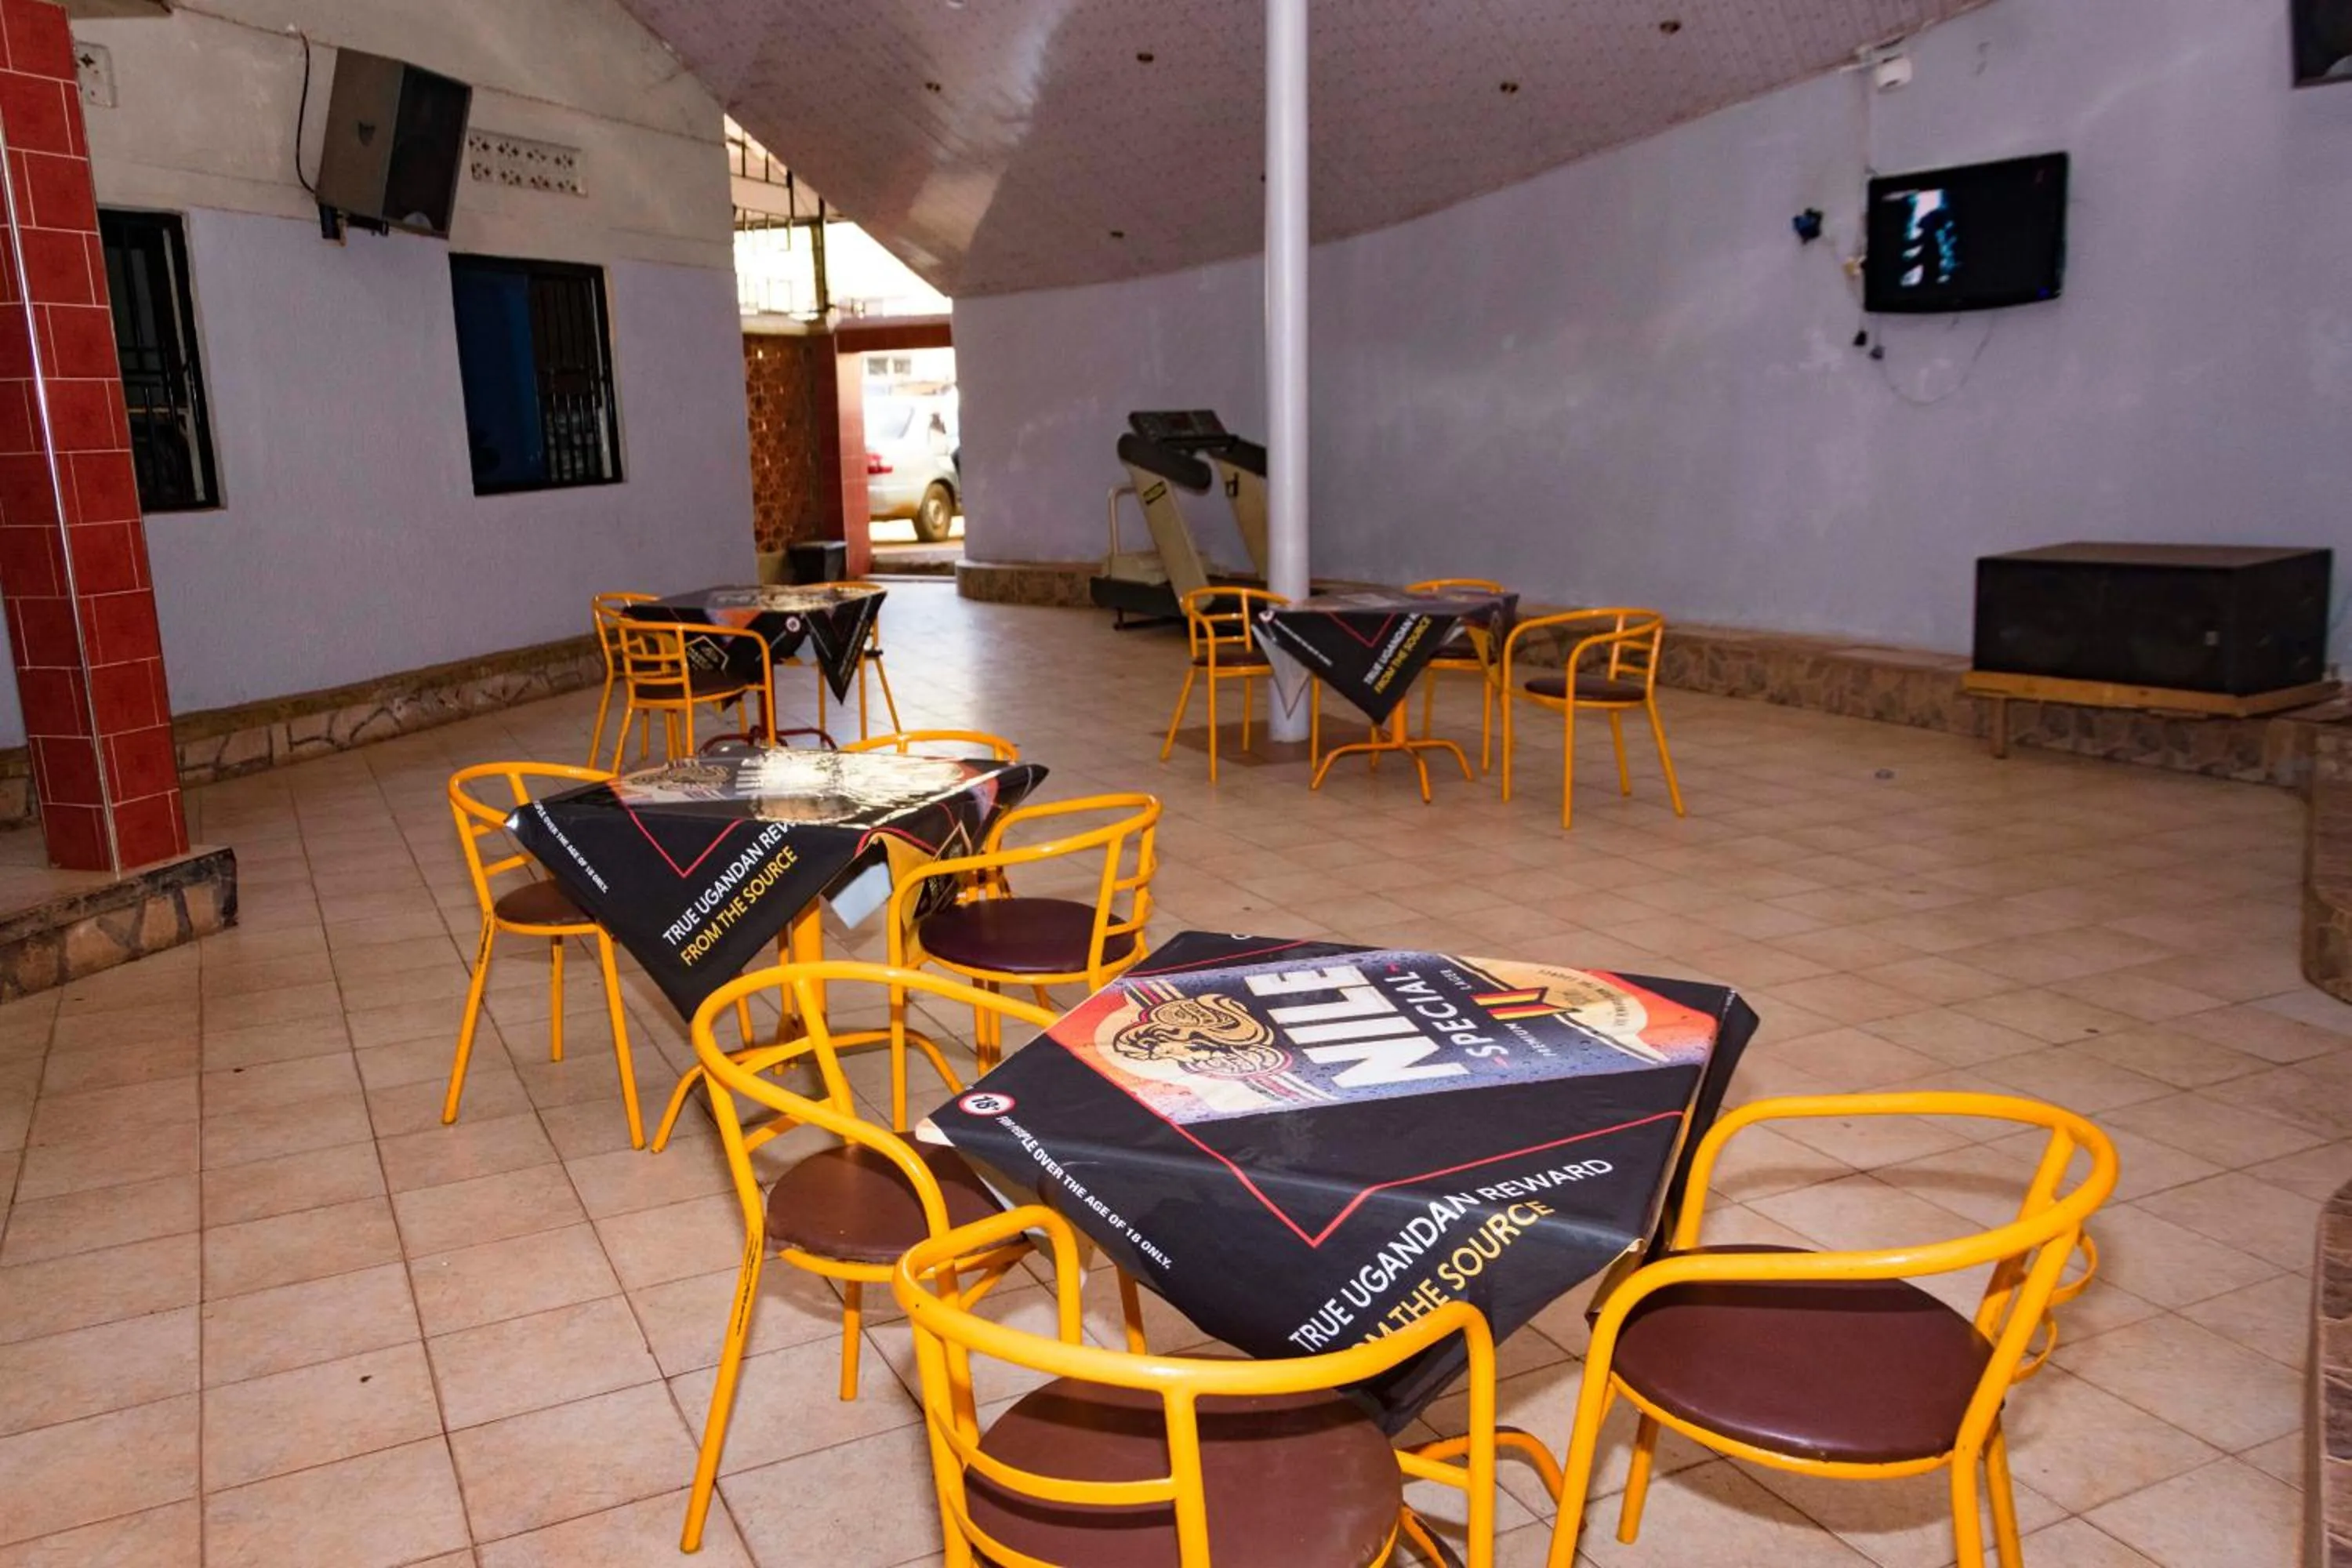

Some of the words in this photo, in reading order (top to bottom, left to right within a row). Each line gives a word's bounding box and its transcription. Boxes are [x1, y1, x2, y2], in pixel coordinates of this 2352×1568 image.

[662, 907, 701, 946] TRUE
[695, 842, 764, 914] UGANDAN
[680, 921, 724, 967] FROM
[716, 896, 749, 928] THE
[742, 844, 799, 904] SOURCE
[1244, 964, 1471, 1089] NILE
[1384, 971, 1509, 1058] SPECIAL
[1033, 1148, 1065, 1180] OVER
[1063, 1174, 1088, 1199] THE
[1082, 1195, 1111, 1218] AGE
[1108, 1214, 1127, 1229] OF
[1125, 1227, 1142, 1243] 18
[1141, 1240, 1173, 1270] ONLY.
[1288, 1298, 1355, 1353] TRUE
[1340, 1192, 1481, 1308] UGANDAN
[1475, 1159, 1613, 1201] REWARD
[1387, 1278, 1450, 1328] THE
[1437, 1200, 1556, 1292] SOURCE
